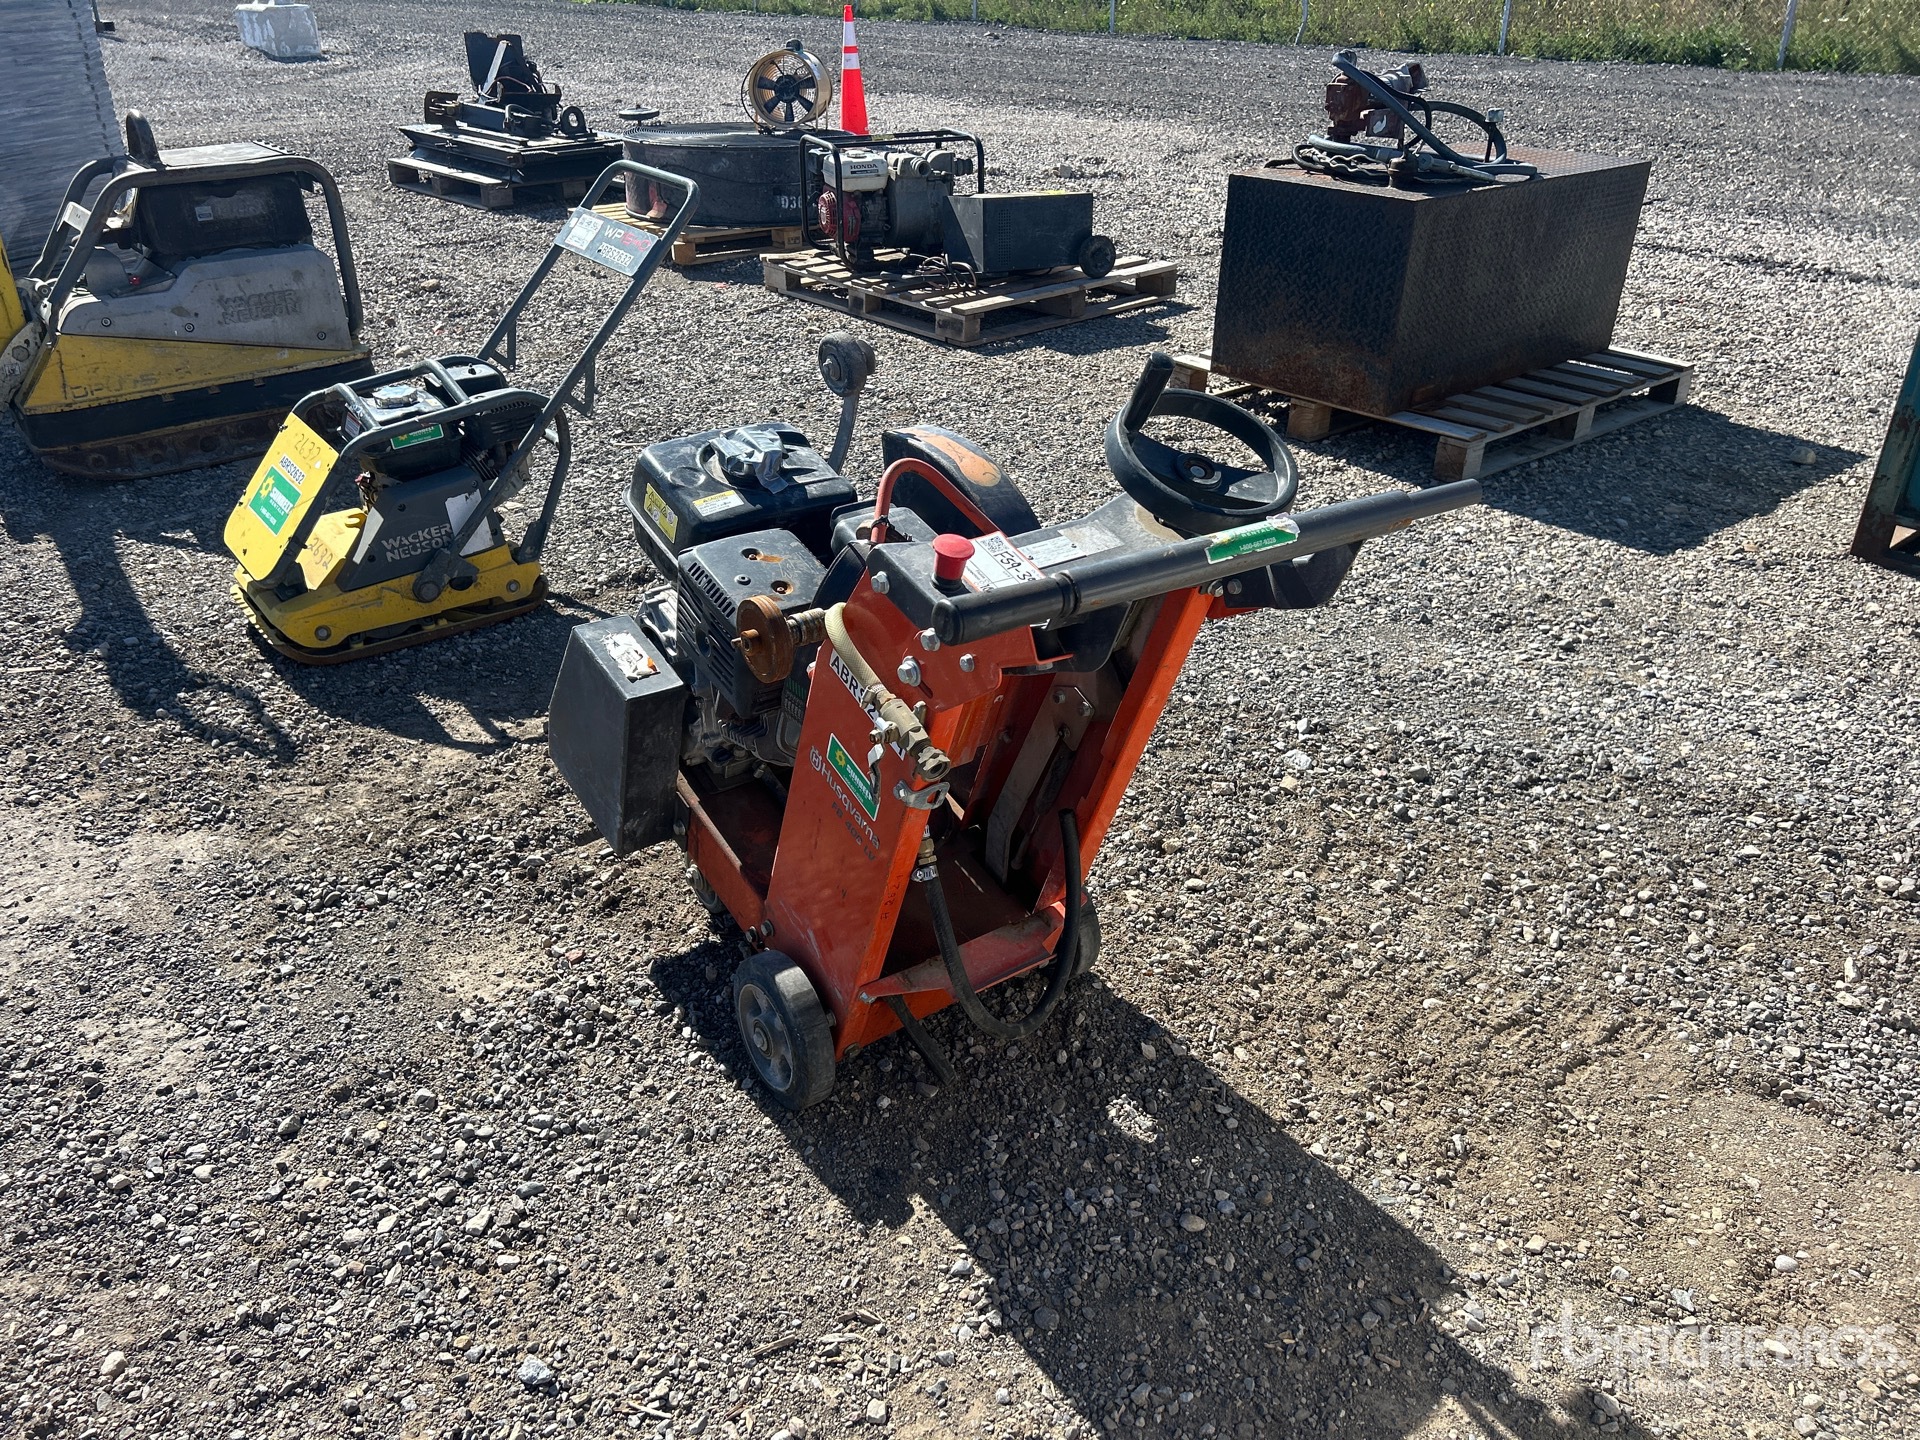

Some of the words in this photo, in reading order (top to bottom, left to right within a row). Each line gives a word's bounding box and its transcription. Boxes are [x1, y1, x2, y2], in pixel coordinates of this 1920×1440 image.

[280, 455, 306, 485] ABRS2632
[381, 522, 452, 550] WACKER
[1241, 526, 1275, 538] RENTALS
[308, 537, 334, 571] 2632
[821, 762, 880, 849] Husqvarna
